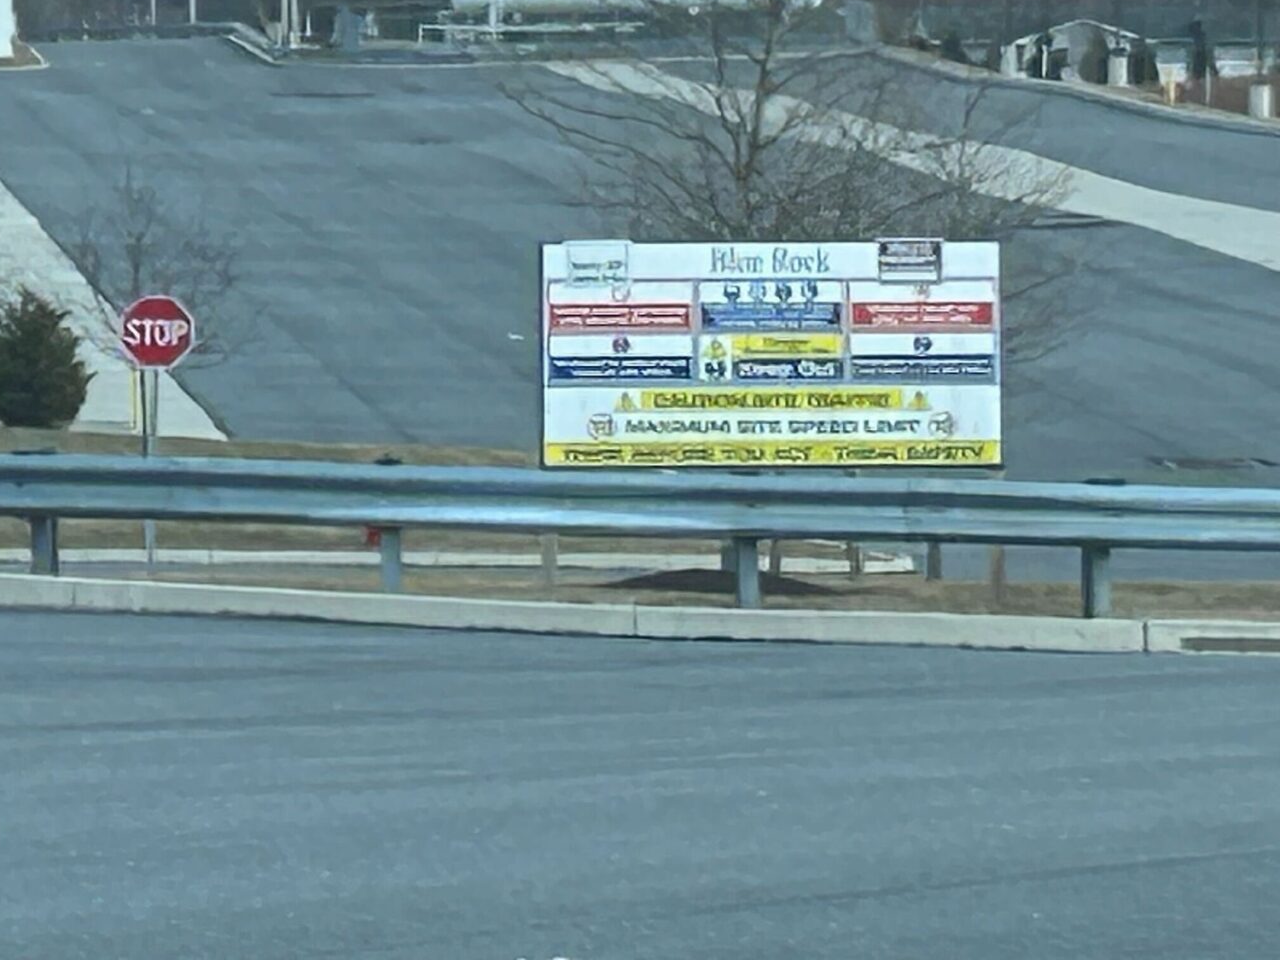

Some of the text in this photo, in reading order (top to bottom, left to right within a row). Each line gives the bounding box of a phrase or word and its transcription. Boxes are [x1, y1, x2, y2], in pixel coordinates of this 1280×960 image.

[123, 318, 188, 346] STOP
[625, 420, 731, 434] MAXIMUM
[737, 420, 782, 434] SITE
[788, 420, 858, 434] SPEED
[863, 419, 920, 434] LIMIT
